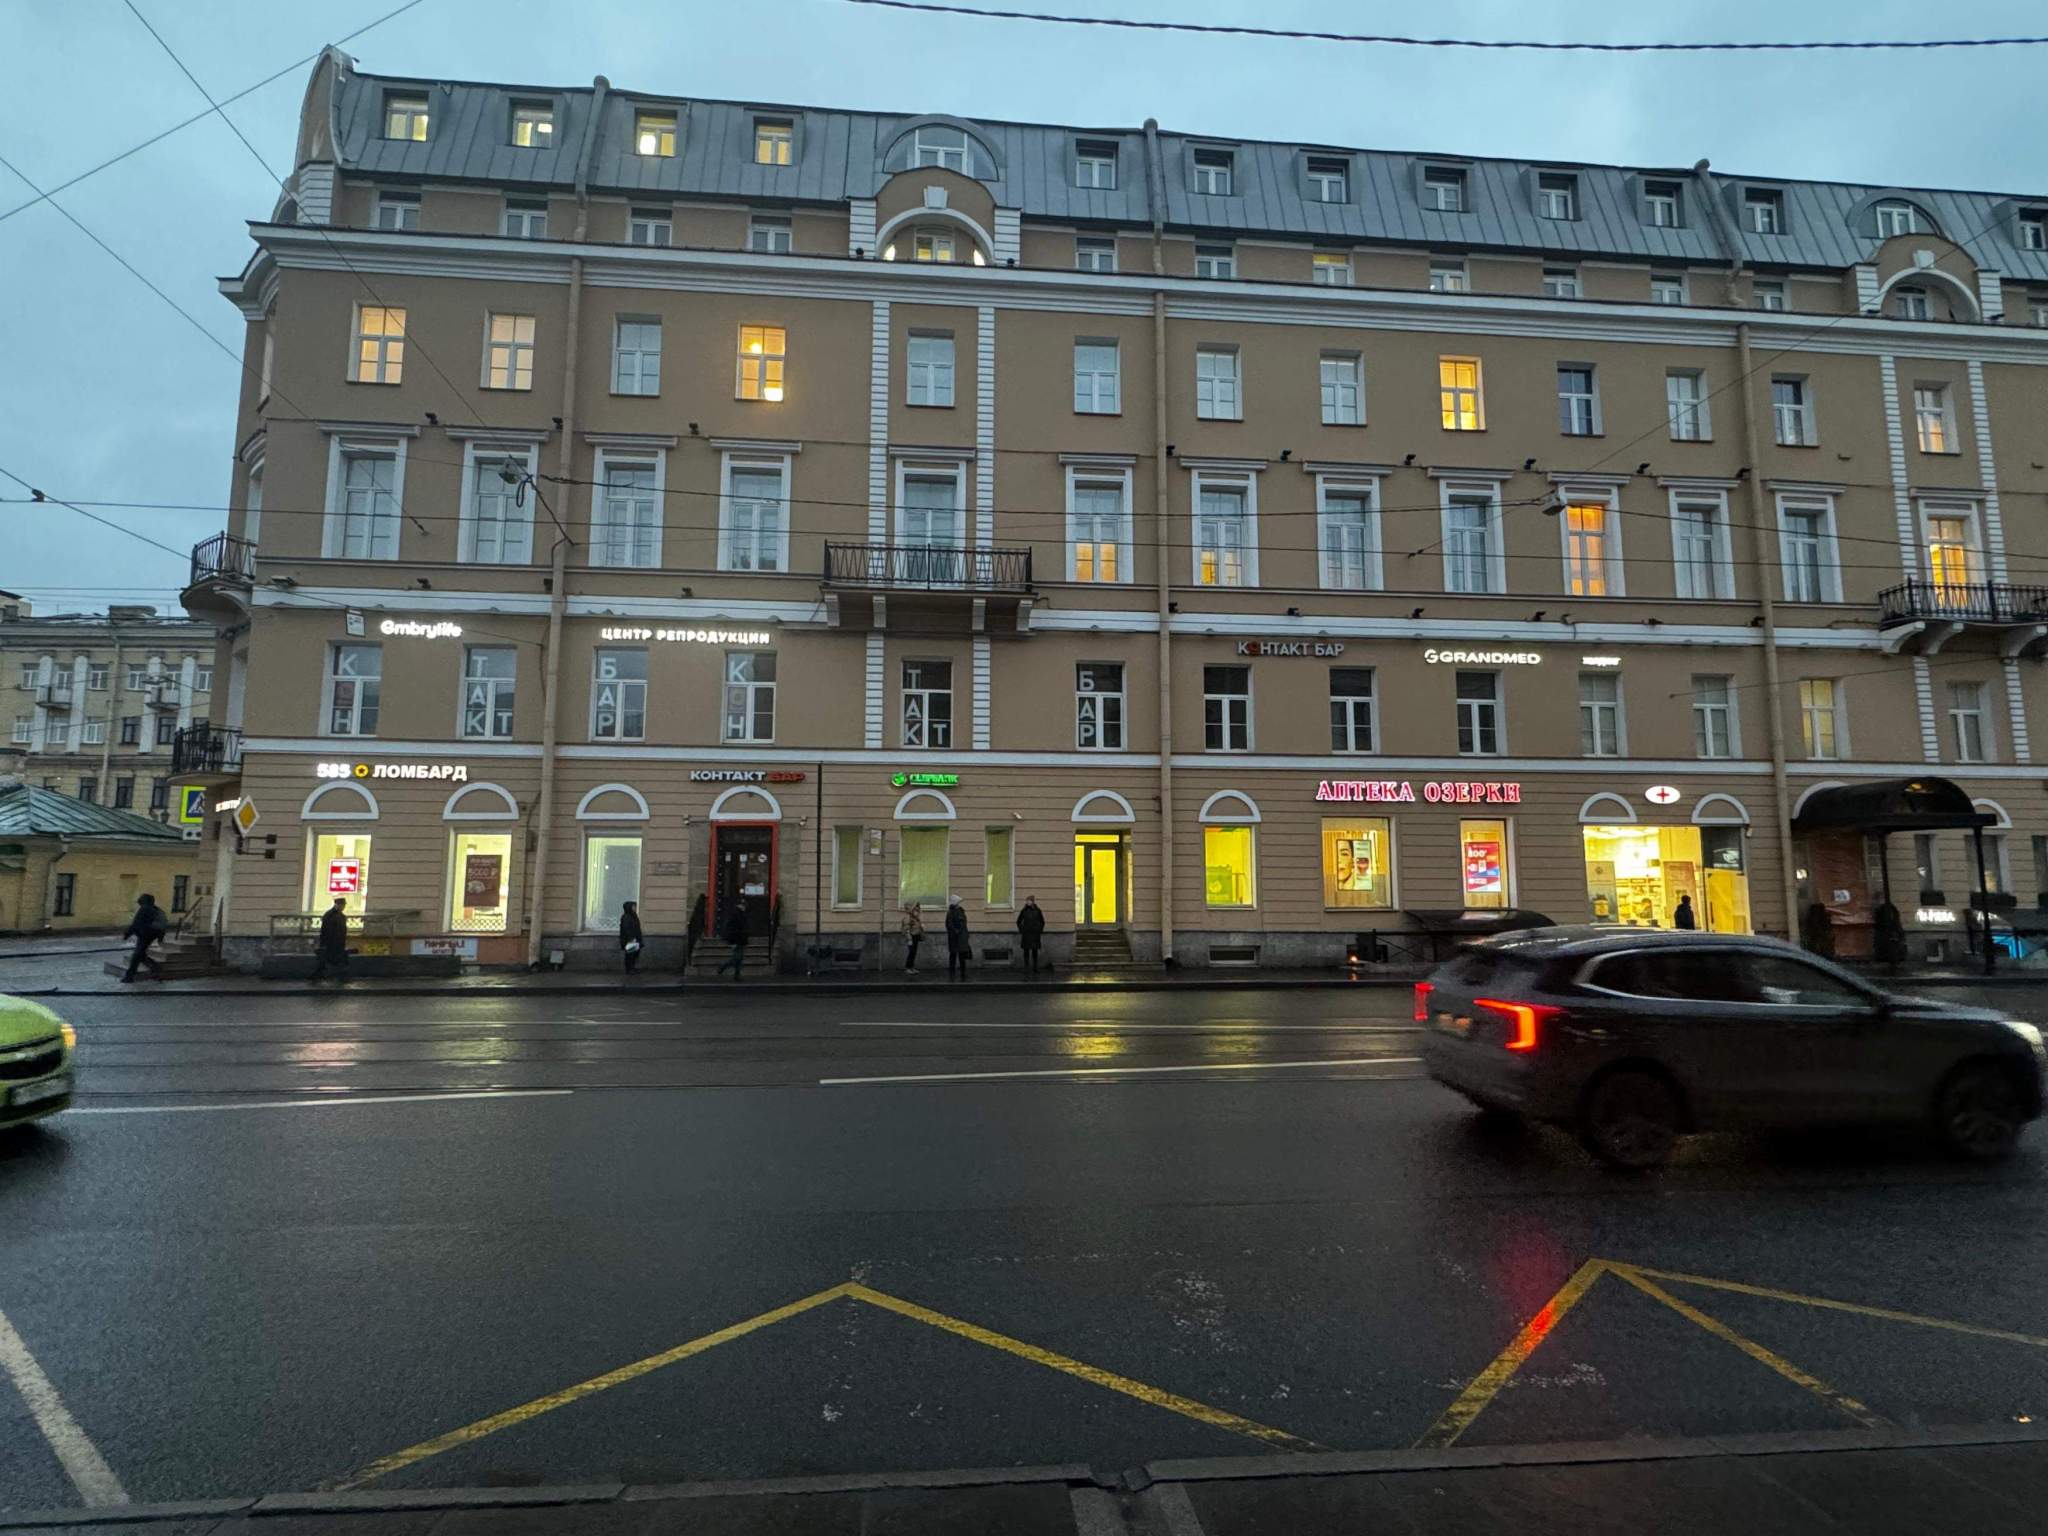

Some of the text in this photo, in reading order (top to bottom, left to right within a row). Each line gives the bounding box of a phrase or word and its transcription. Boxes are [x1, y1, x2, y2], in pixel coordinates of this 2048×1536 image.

[601, 627, 770, 645] ЦЕНТР РЕПРОДУКЦИИ
[1315, 643, 1345, 656] БАР
[1439, 651, 1541, 664] GRANDMED
[316, 763, 351, 778] 585
[372, 764, 467, 781] ЛОМБАРД
[690, 770, 765, 781] КОНТАКТ
[1315, 780, 1521, 803] АПТЕКА ОЗЕРКИ
